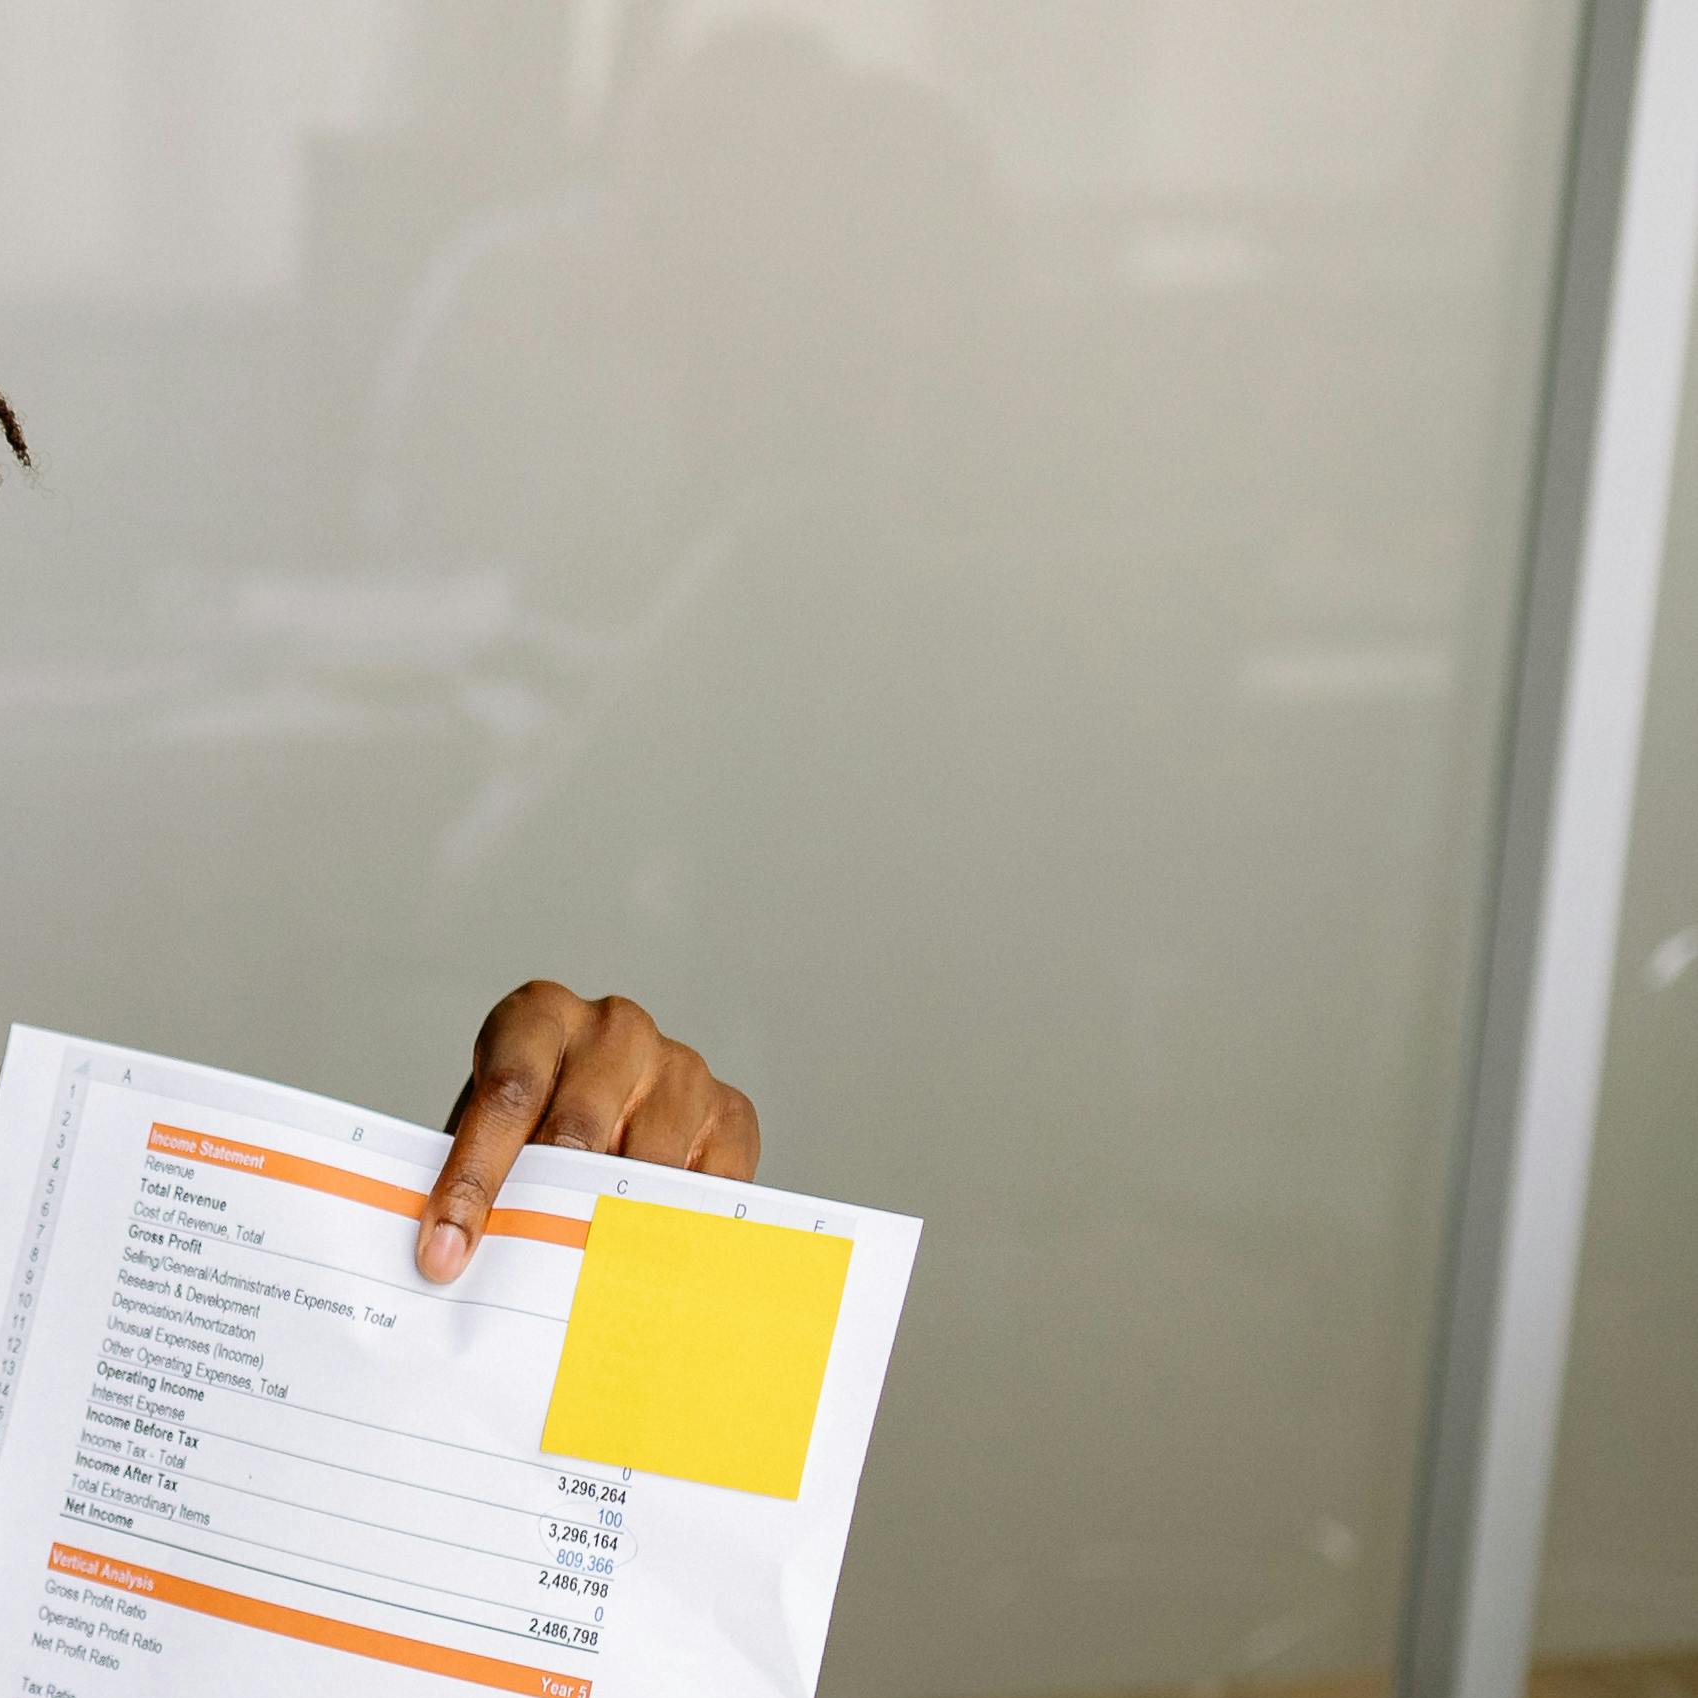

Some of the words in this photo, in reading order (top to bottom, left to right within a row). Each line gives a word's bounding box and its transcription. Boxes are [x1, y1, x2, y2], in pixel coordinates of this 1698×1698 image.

[152, 1128, 197, 1155] Income
[200, 1142, 265, 1169] Statement
[352, 1127, 364, 1142] B
[145, 1155, 195, 1181] Revenue
[617, 1180, 628, 1194] C
[140, 1178, 171, 1198] Total
[175, 1187, 227, 1212] Revenue
[734, 1204, 747, 1219] D
[129, 1224, 164, 1246] Gross
[168, 1235, 202, 1255] Profit
[134, 1201, 160, 1222] Cost
[162, 1208, 174, 1224] of
[177, 1211, 230, 1239] Revenue,
[236, 1225, 265, 1246] Total
[118, 1270, 171, 1297] Research
[175, 1283, 183, 1298] &
[186, 1288, 260, 1318] Development
[294, 1289, 355, 1319] Expenses,
[363, 1306, 397, 1329] Total
[112, 1292, 256, 1342] Depreciation/Amortization
[107, 1316, 153, 1340] Unusual
[155, 1327, 211, 1357] Expenses
[214, 1342, 264, 1371] (Income)
[97, 1361, 157, 1392] Operating
[160, 1377, 205, 1401] Income
[102, 1338, 134, 1359] Other
[137, 1346, 193, 1377] Operating
[196, 1363, 255, 1392] Expenses,
[260, 1378, 289, 1399] Total
[92, 1384, 133, 1407] Interest
[136, 1395, 186, 1423] Expense
[86, 1406, 131, 1431] Income
[134, 1420, 174, 1443] Before
[178, 1432, 199, 1449] Tax
[81, 1430, 122, 1453] Income
[125, 1441, 147, 1459] Tax
[158, 1448, 187, 1470] Total
[75, 1452, 120, 1477] Income
[123, 1464, 153, 1486] After
[157, 1474, 178, 1492] Tax
[558, 1476, 627, 1506] 3,296,264
[66, 1497, 88, 1516] Net
[89, 1505, 134, 1529] Income
[71, 1474, 98, 1496] Total
[101, 1481, 176, 1520] Extraordinary
[179, 1503, 210, 1526] Items
[597, 1509, 623, 1529] 100
[548, 1523, 618, 1551] 3,296,164
[53, 1550, 97, 1577] Vertical
[100, 1563, 154, 1592] Analysis
[538, 1570, 609, 1599] 2,486,798
[45, 1580, 80, 1602] Gross
[82, 1590, 114, 1613] Profit
[116, 1600, 147, 1622] Ratio
[594, 1606, 604, 1622] 0
[38, 1606, 94, 1638] Operating
[100, 1623, 130, 1646] Profit
[132, 1631, 163, 1654] Ratio
[529, 1618, 599, 1647] 2,486,798
[32, 1632, 53, 1652] Net
[56, 1639, 86, 1661] Profit
[89, 1649, 120, 1671] Ratio
[22, 1677, 43, 1697] Tax
[540, 1676, 575, 1698] Year
